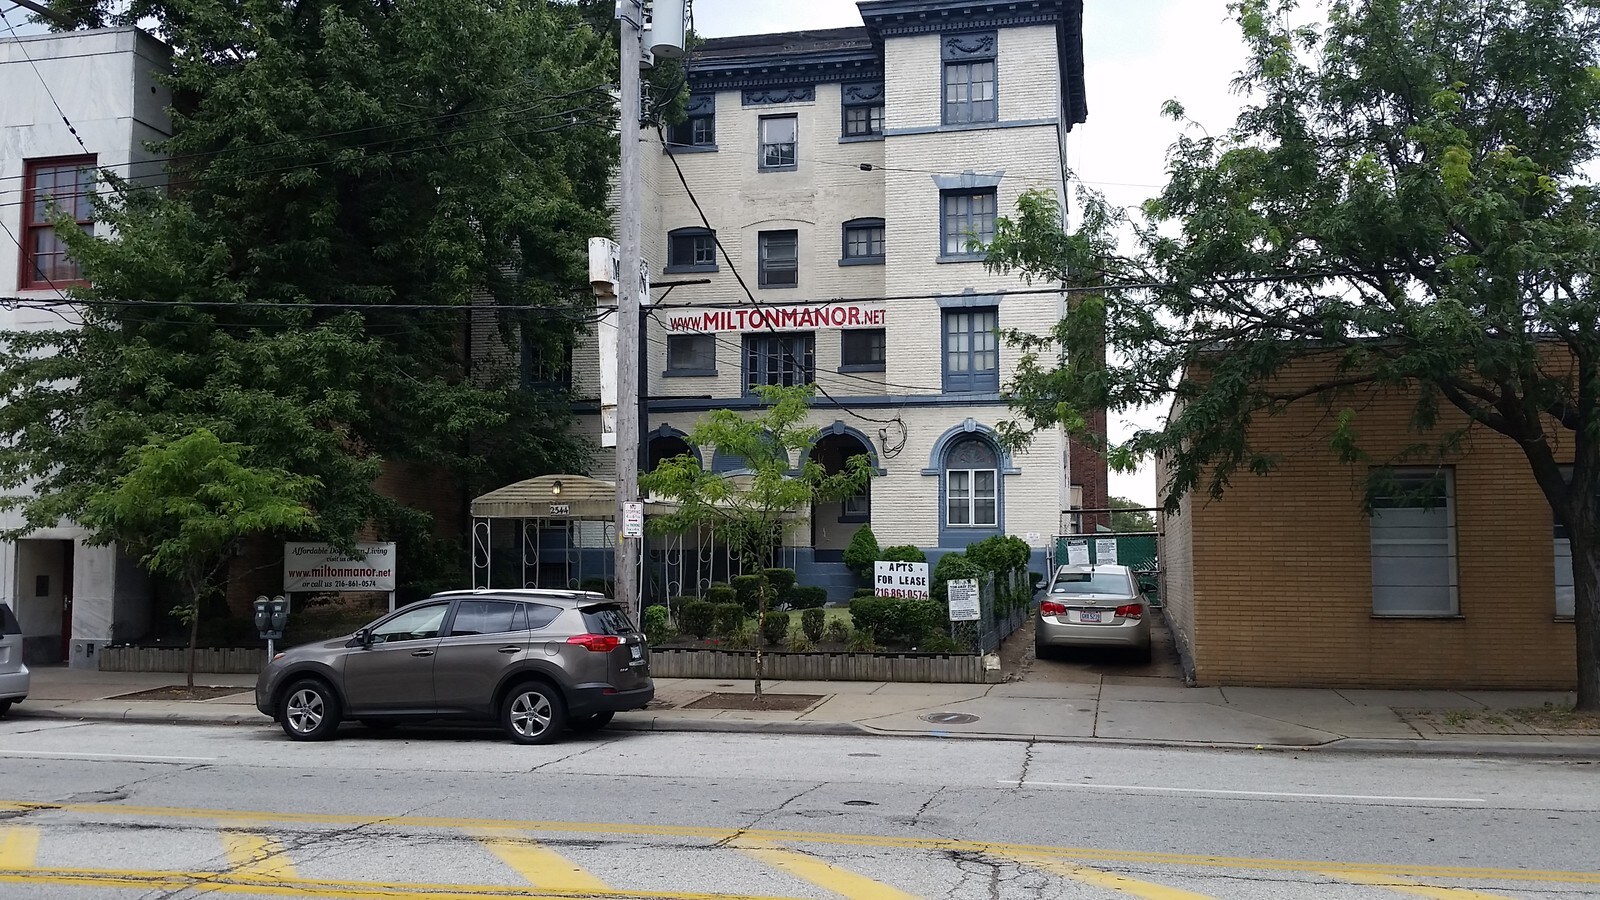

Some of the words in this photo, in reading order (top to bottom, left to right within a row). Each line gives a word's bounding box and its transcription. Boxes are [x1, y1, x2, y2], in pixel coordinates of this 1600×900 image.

[669, 306, 886, 332] WWW.MILTONMANOR.NET
[550, 506, 569, 515] 2544
[292, 547, 328, 556] Affordable
[366, 546, 388, 556] Living
[288, 565, 391, 577] www.miltonmanor.net
[311, 580, 323, 588] call
[335, 580, 376, 588] 216-861-0574
[877, 575, 893, 584] FOR
[899, 576, 926, 586] LEASE
